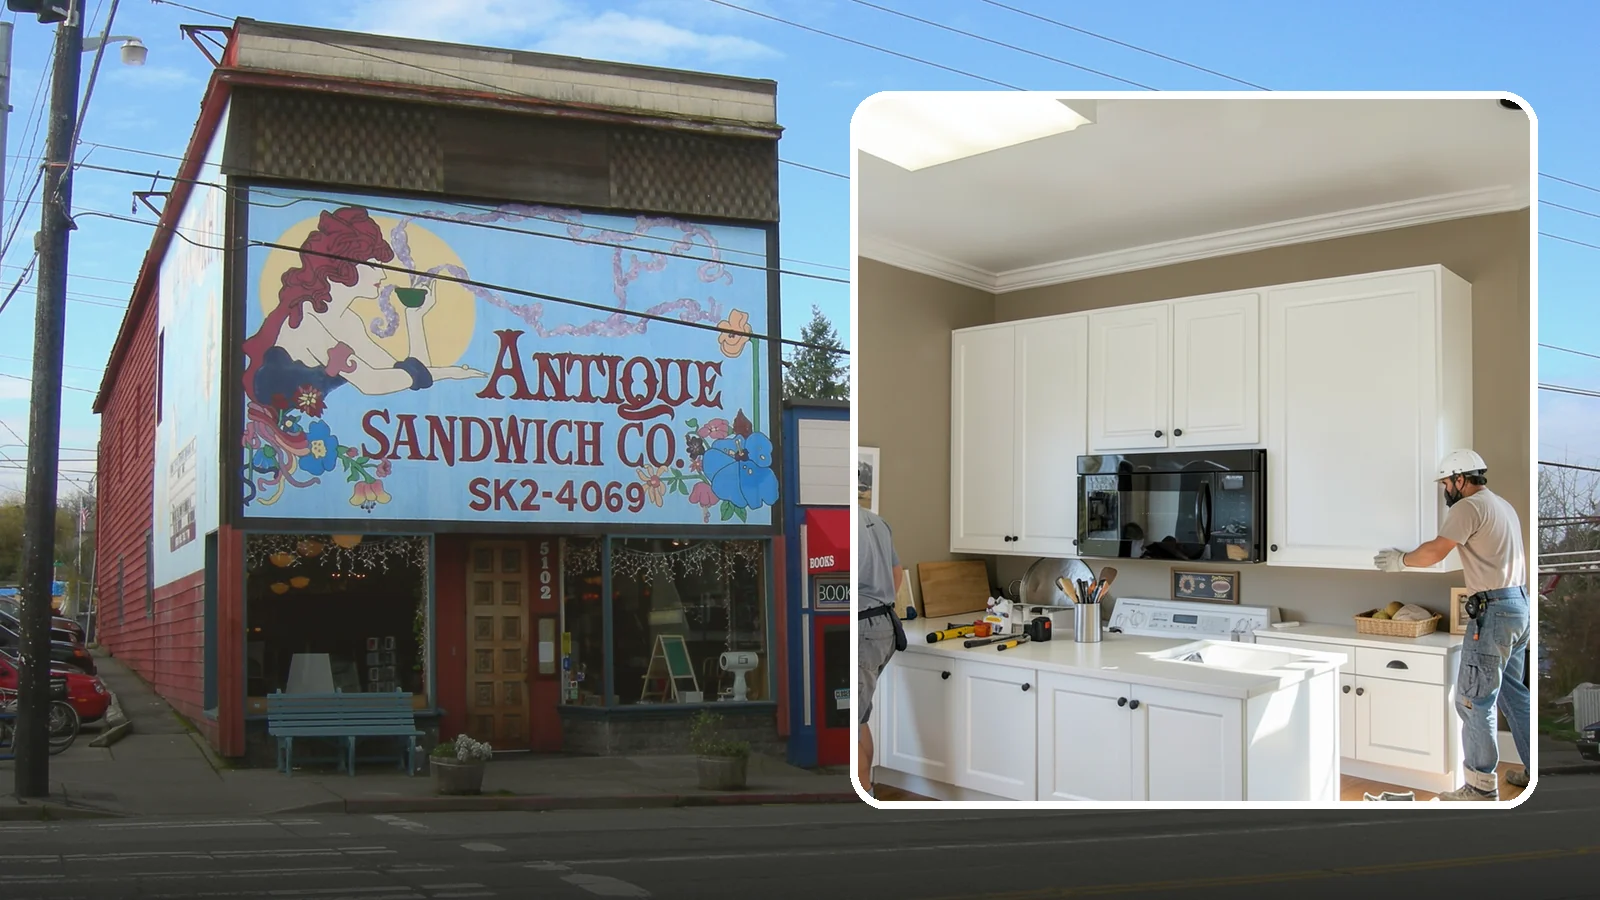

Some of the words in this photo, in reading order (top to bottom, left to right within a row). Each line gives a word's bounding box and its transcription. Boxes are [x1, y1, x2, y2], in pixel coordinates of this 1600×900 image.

[476, 329, 723, 421] ANTIQUE
[361, 408, 604, 467] SANDWICH
[617, 421, 685, 469] CO.
[468, 476, 646, 513] SK2-4069
[540, 541, 552, 600] 5102
[809, 554, 835, 569] BOOKS
